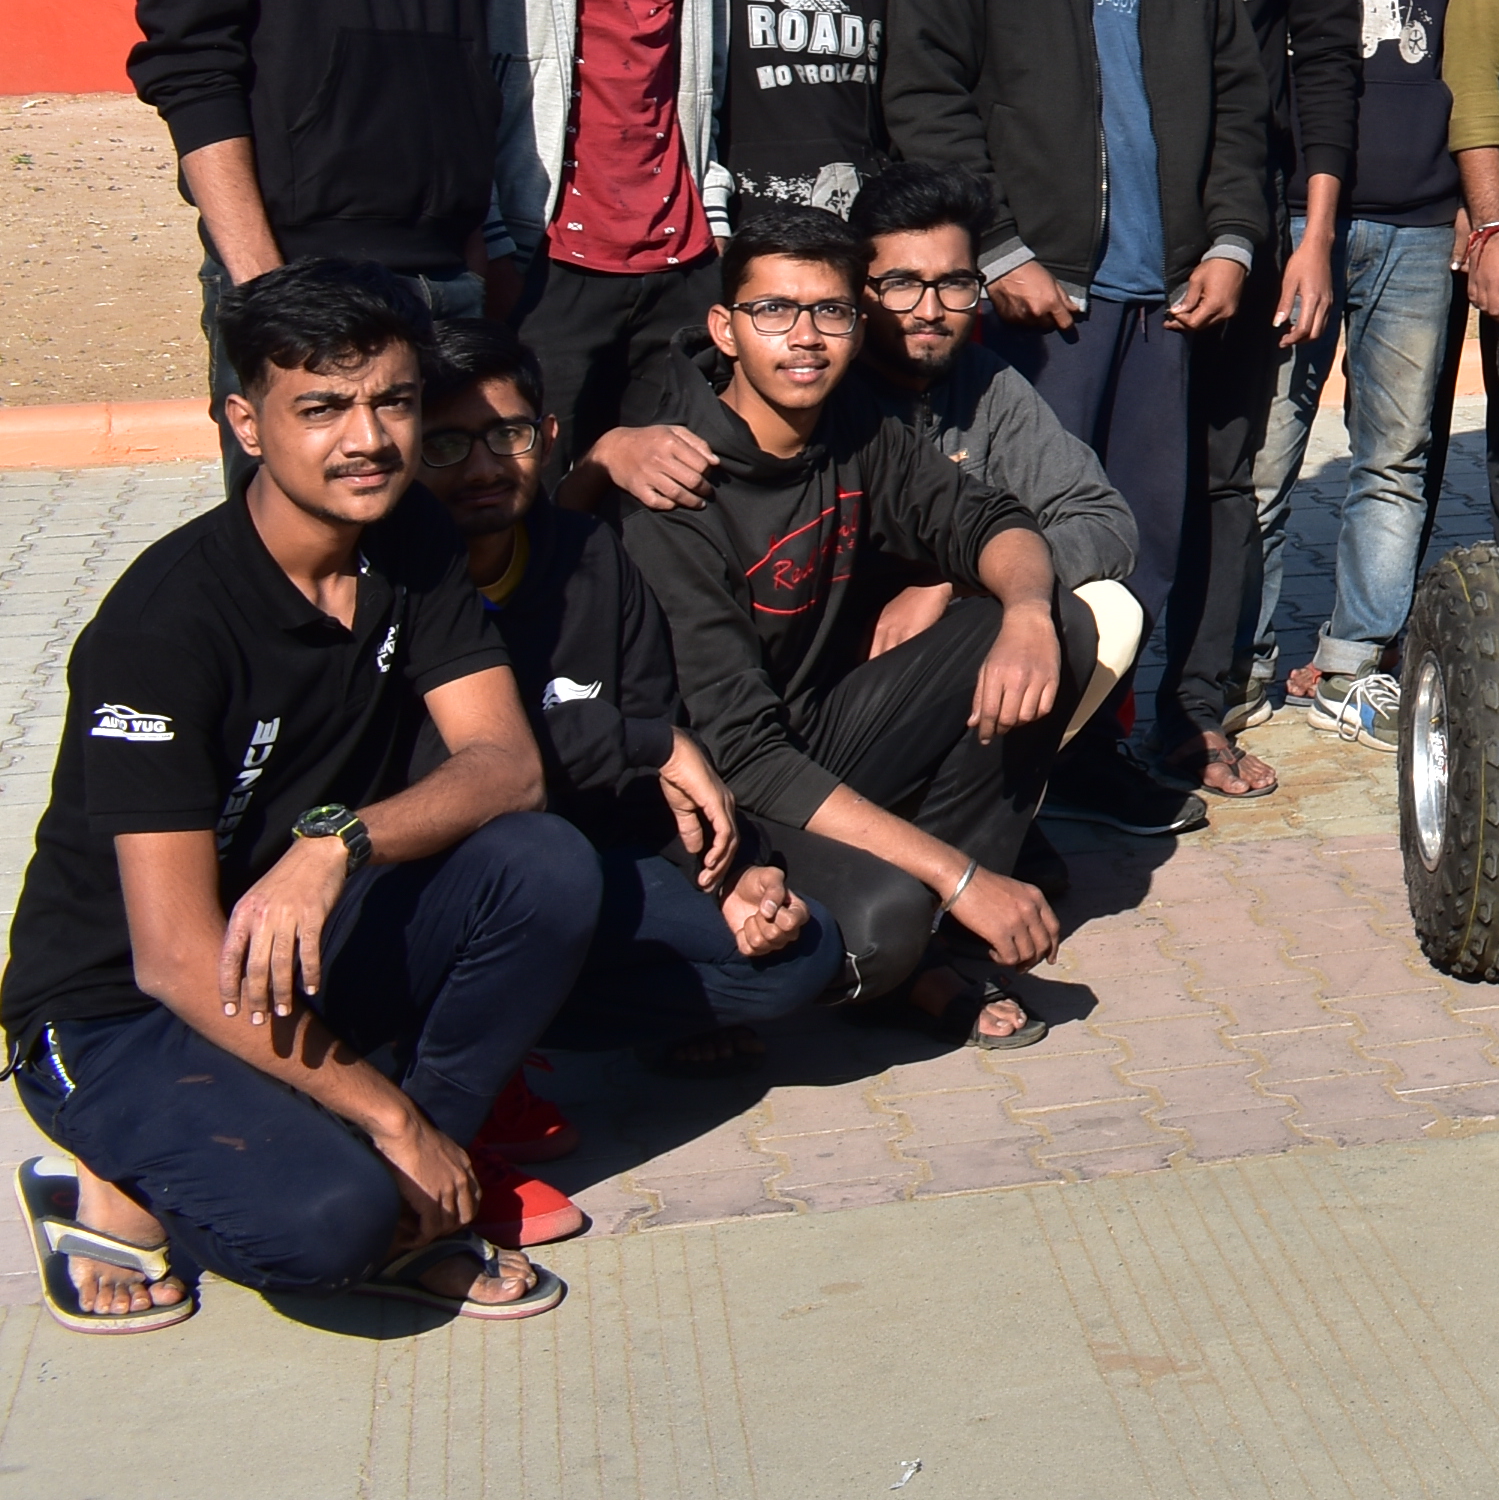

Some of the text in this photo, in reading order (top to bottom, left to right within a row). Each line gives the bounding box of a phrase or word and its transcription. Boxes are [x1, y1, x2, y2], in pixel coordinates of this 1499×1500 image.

[747, 5, 883, 63] ROADS
[756, 64, 793, 90] NO
[131, 720, 167, 733] YUG
